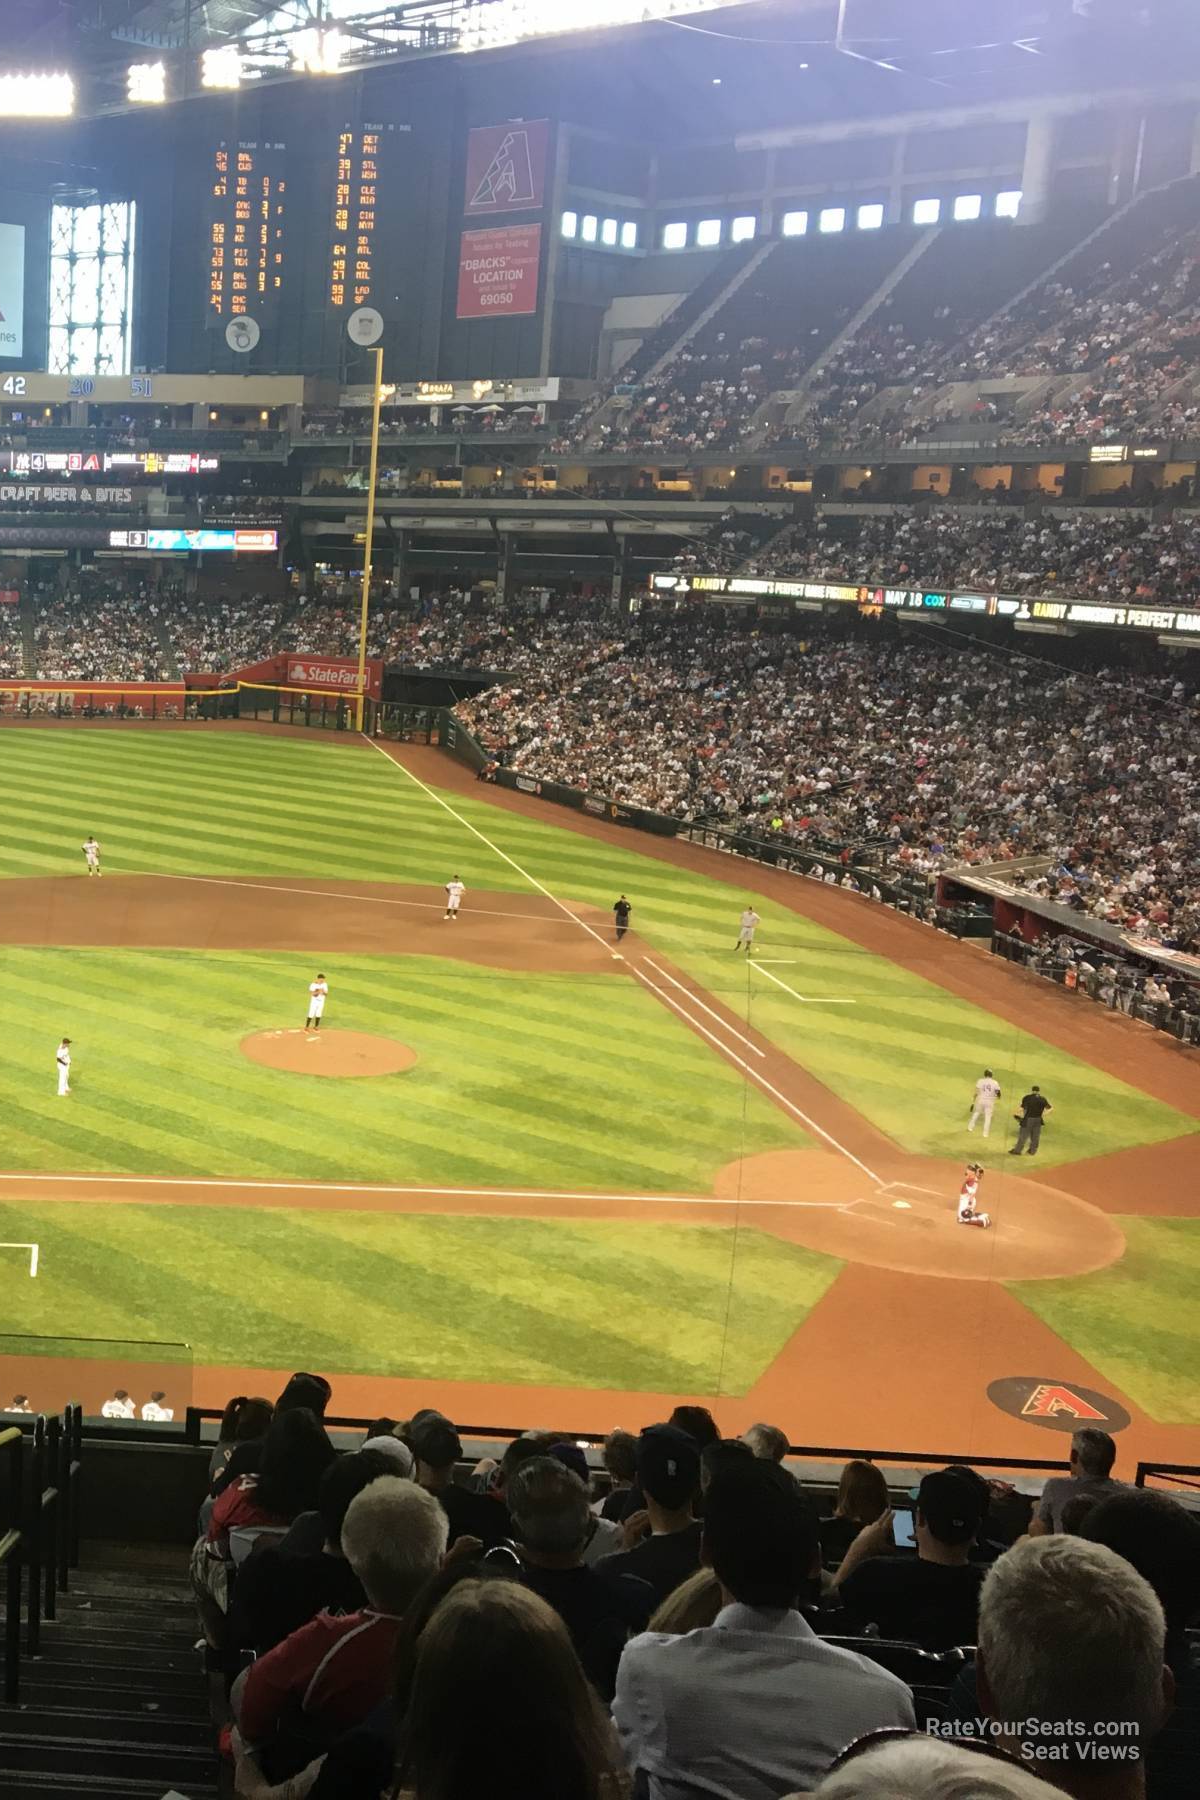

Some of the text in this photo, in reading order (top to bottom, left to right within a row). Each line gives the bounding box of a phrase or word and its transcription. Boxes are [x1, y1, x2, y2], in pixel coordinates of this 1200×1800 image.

[340, 134, 378, 143] 47 DET
[340, 144, 376, 153] 2 PHI
[339, 159, 376, 169] 39 STL
[338, 170, 350, 179] 31
[214, 186, 226, 195] 57
[361, 186, 375, 194] CLE
[337, 196, 374, 204] 31 MIA
[262, 201, 268, 210] 3
[360, 212, 374, 220] CIN
[213, 224, 224, 233] 55
[334, 245, 371, 255] 64 ATL
[333, 260, 371, 270] 49 COL
[333, 271, 344, 279] 57
[473, 269, 523, 283] LOCATION
[211, 281, 222, 290] 55
[274, 277, 280, 286] 3
[332, 285, 343, 294] 99
[332, 295, 343, 304] 40
[481, 293, 512, 305] 69050
[3, 376, 151, 397] 42 20 51
[1, 487, 40, 500] CRAFT
[44, 487, 76, 501] BEER
[80, 488, 92, 500] &
[96, 488, 131, 502] BITES
[693, 578, 726, 591] RANDY
[885, 590, 906, 604] MAY
[909, 592, 922, 606] 18
[925, 594, 946, 607] COX
[1033, 602, 1066, 618] RANDY
[1068, 604, 1125, 624] JOHNSON'S
[1127, 607, 1175, 628] PERFECT
[308, 667, 336, 682] State
[18, 687, 75, 708] Farm
